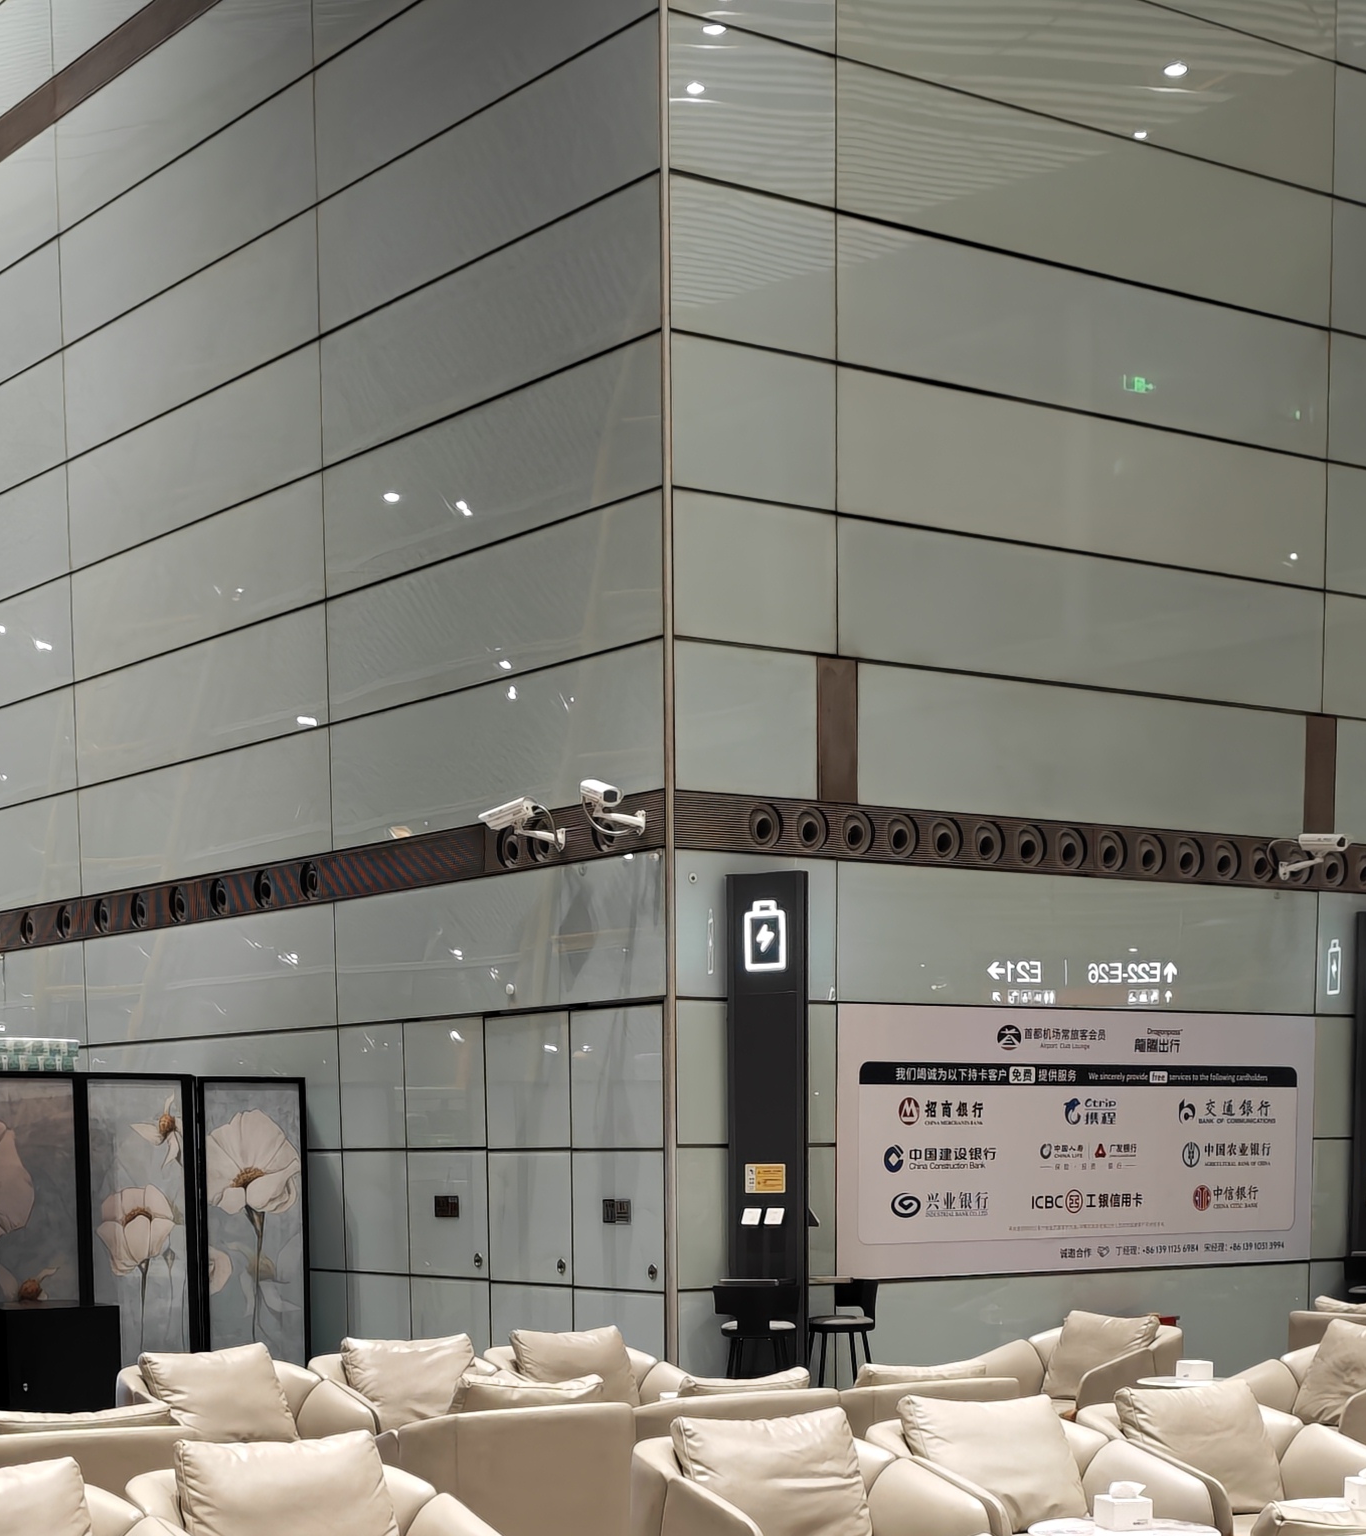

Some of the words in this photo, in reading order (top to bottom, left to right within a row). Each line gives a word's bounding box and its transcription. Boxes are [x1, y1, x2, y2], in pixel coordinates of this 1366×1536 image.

[1011, 1068, 1034, 1083] 免费
[1038, 1068, 1077, 1083] 提供服务
[1088, 1071, 1099, 1080] We
[1099, 1071, 1125, 1082] sincerely
[1126, 1072, 1148, 1082] provide
[1151, 1072, 1166, 1082] free
[1169, 1073, 1192, 1081] services
[1199, 1073, 1209, 1082] the
[1210, 1073, 1235, 1083] following
[1084, 1098, 1117, 1108] Ctrip
[1084, 1111, 1116, 1125] 携程
[909, 1147, 997, 1161] 中国建设银行
[1204, 1142, 1272, 1157] 中国农业银行
[909, 1162, 928, 1170] China
[929, 1162, 969, 1170] Construction
[969, 1161, 986, 1170] Bank
[1213, 1185, 1259, 1201] 中信银行
[925, 1191, 989, 1210] 兴业银行
[1031, 1194, 1064, 1209] ICBC
[1085, 1192, 1143, 1208] 工银信用卡
